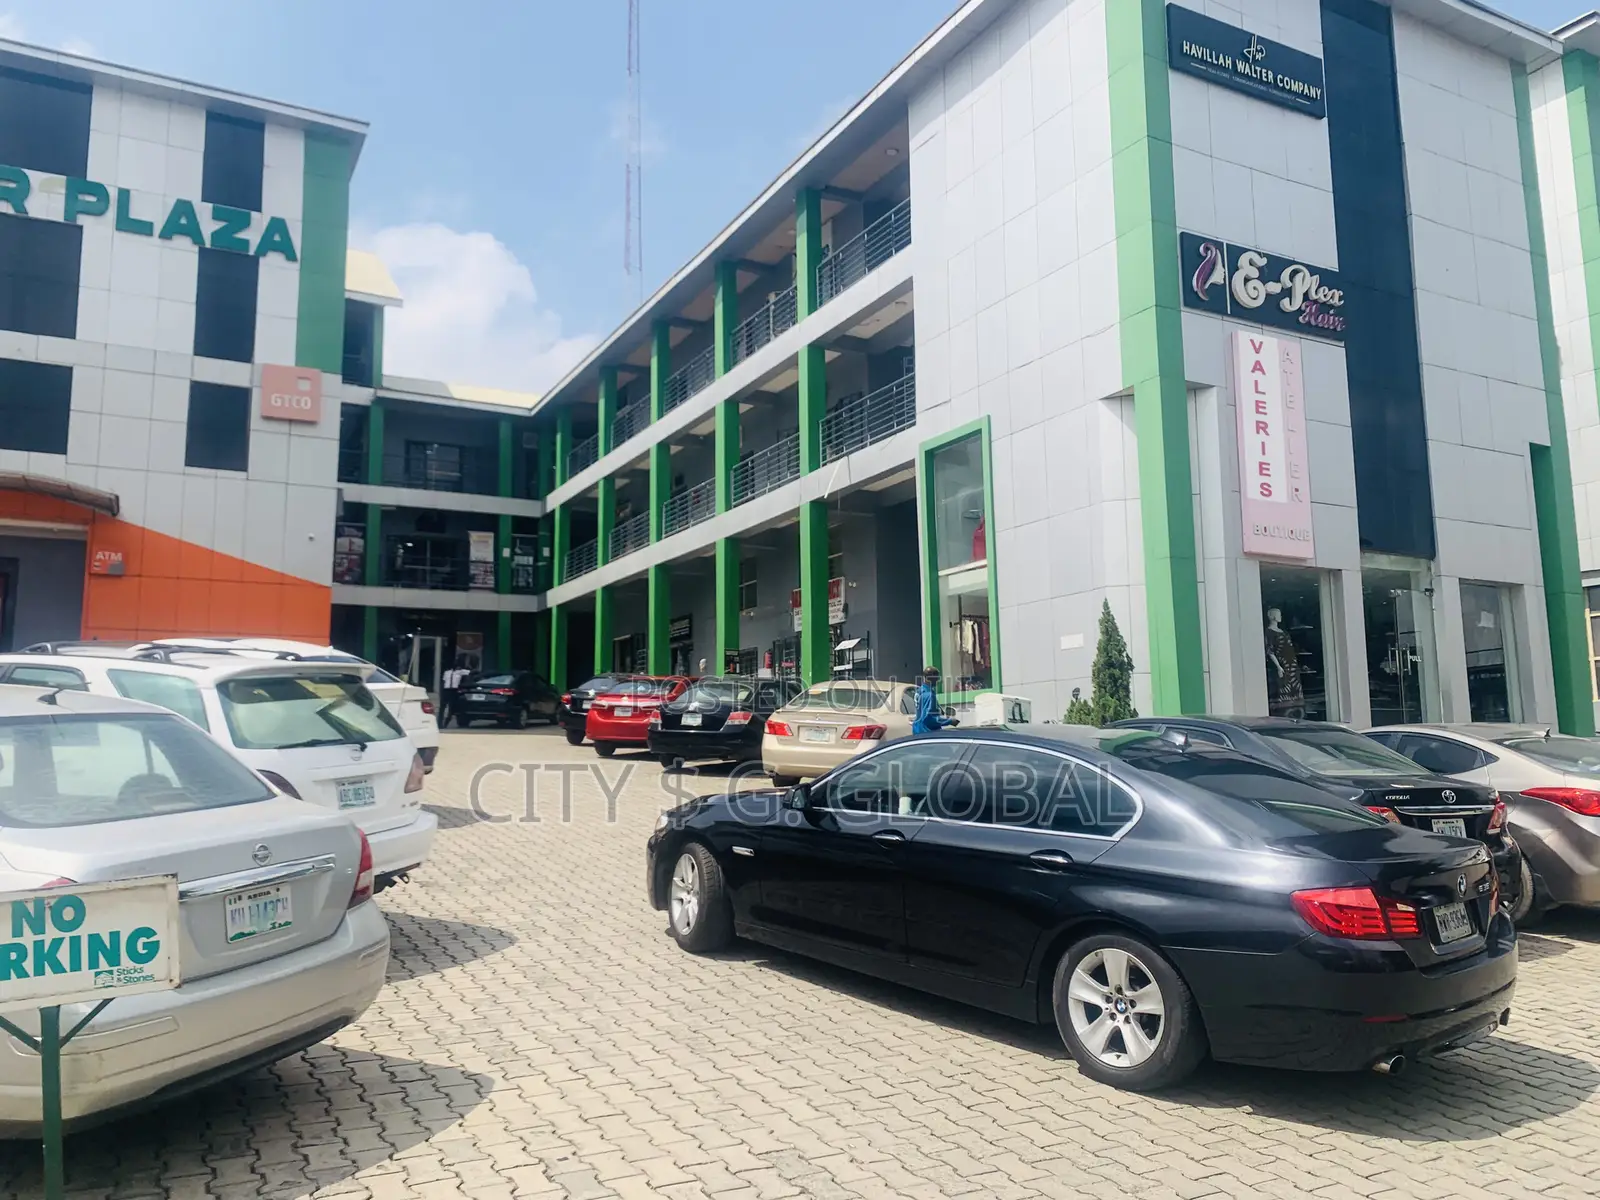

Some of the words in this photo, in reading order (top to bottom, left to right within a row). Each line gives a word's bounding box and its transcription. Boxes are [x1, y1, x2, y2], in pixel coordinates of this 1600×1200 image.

[1183, 40, 1232, 70] HAVILLAH
[1236, 58, 1274, 84] WALTER
[1276, 74, 1322, 101] COMPANY
[63, 176, 299, 263] PLAZA
[1231, 250, 1344, 313] E-Plex
[1299, 300, 1346, 332] Hair
[271, 393, 312, 410] GTCO
[1249, 338, 1273, 499] VALERIES
[1253, 523, 1311, 543] BOUTIQUE
[95, 551, 122, 562] ATM
[11, 894, 86, 939] NO
[0, 926, 160, 982] RKING
[116, 966, 144, 977] Sticks
[123, 973, 155, 984] Stones
